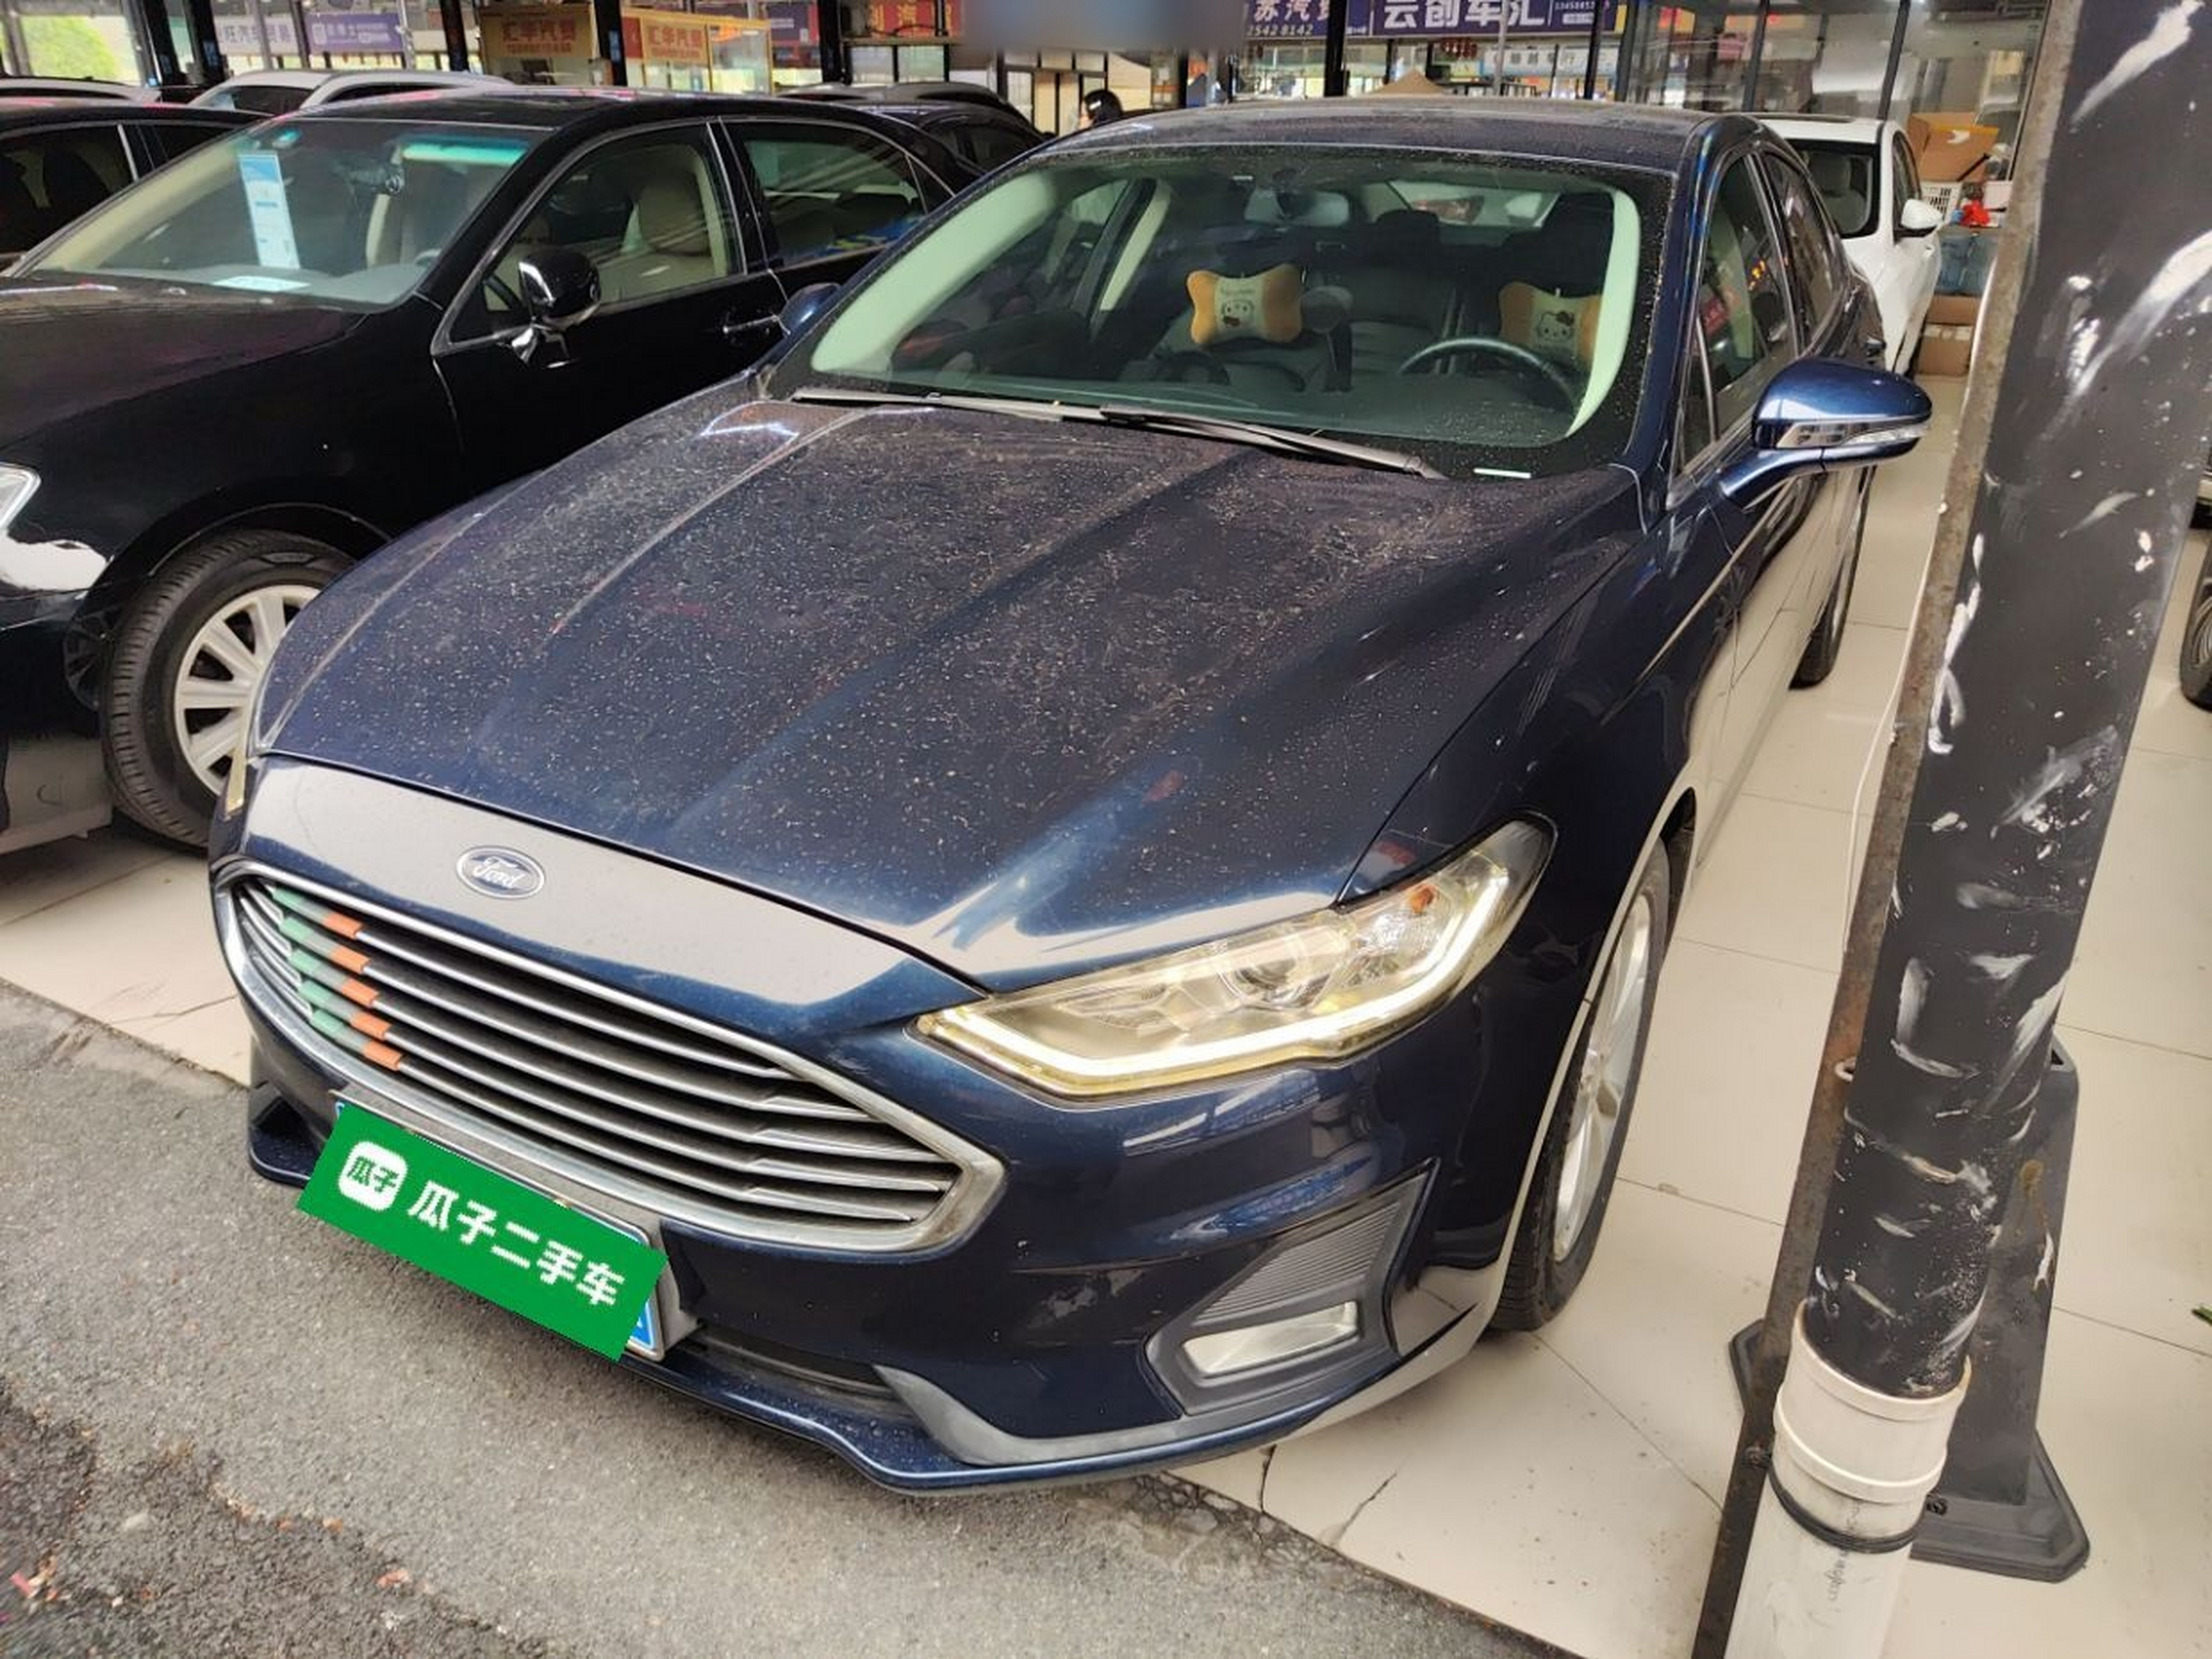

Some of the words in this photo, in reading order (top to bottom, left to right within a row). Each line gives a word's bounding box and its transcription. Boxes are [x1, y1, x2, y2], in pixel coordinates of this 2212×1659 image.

[1384, 0, 1545, 28] 云创车汇
[472, 856, 527, 889] Ford
